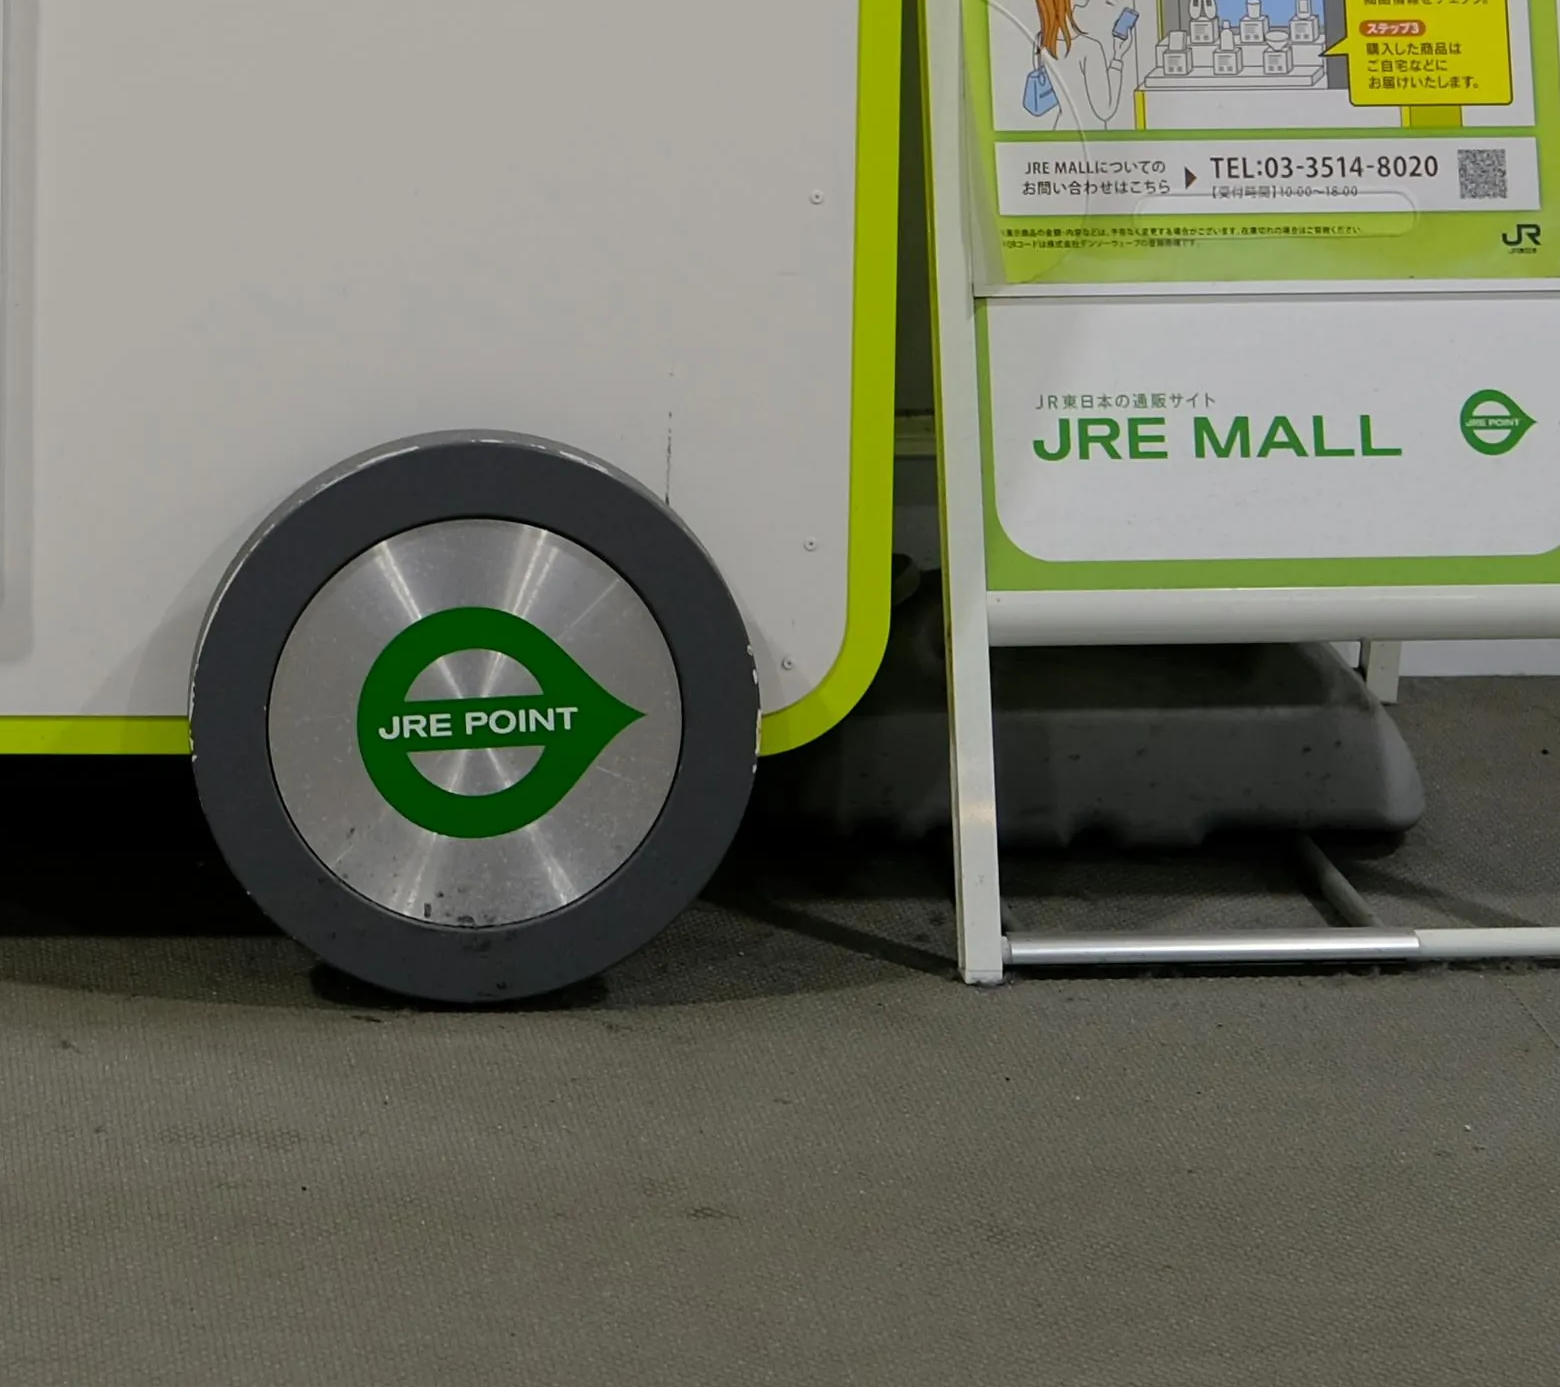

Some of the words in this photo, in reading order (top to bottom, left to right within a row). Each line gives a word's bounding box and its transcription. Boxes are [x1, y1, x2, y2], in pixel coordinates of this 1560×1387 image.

[1366, 23, 1419, 34] ステップ3
[1367, 42, 1461, 55] 購入した商品は
[1368, 60, 1448, 72] ご自宅などに
[1369, 76, 1479, 89] お届けいたします。
[1025, 162, 1050, 174] JRE
[1055, 160, 1166, 175] MALLについての
[1210, 156, 1439, 179] TEL:03-3514-8020
[1023, 179, 1170, 195] お問い合わせはこちら
[1502, 224, 1541, 246] JR
[1035, 393, 1217, 410] JR東日本の通販サイト
[1033, 417, 1168, 462] JRE
[1193, 414, 1402, 458] MALL
[378, 713, 452, 739] JRE
[465, 707, 578, 735] POINT
